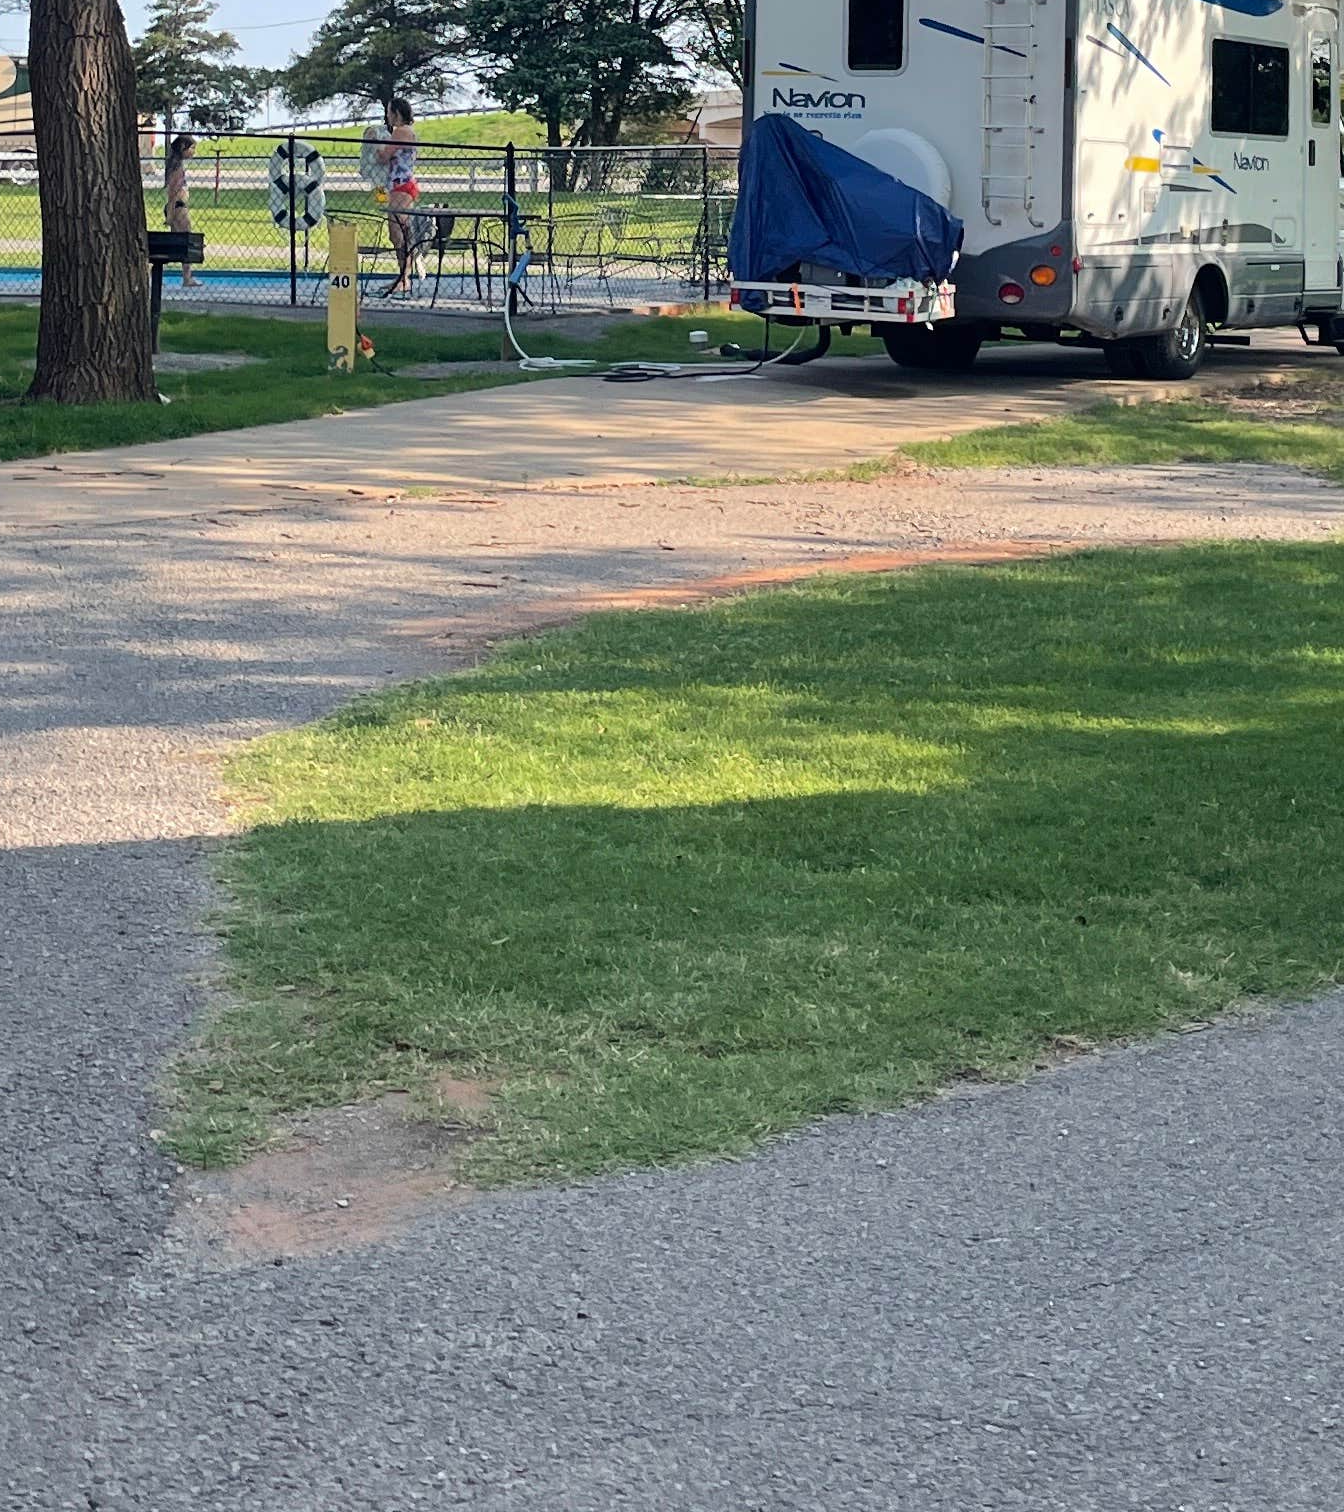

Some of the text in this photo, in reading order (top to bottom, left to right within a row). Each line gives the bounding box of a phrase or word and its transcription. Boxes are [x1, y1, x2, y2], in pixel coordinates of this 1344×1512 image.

[772, 88, 865, 108] Navion
[1233, 152, 1269, 171] Navion
[331, 275, 350, 288] 40
